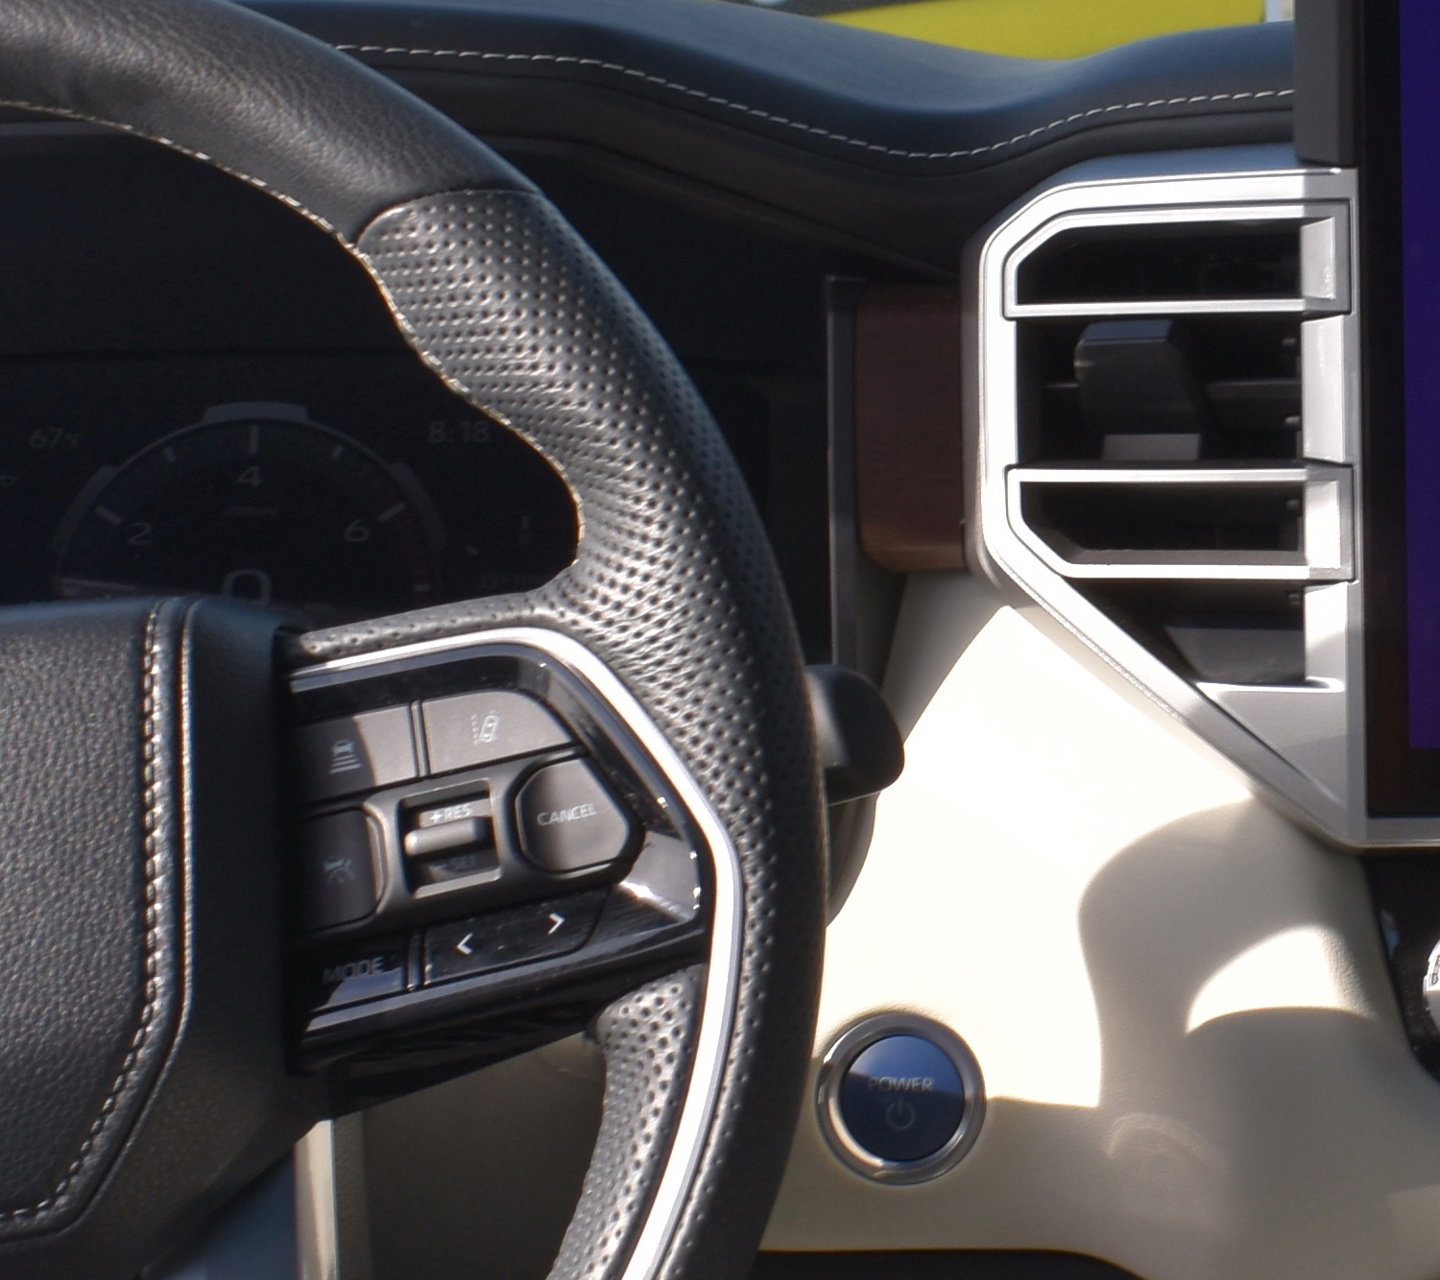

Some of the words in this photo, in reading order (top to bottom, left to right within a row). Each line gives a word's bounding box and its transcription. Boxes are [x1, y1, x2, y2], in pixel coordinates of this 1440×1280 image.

[236, 463, 262, 489] 4
[127, 521, 154, 546] 2
[343, 519, 371, 542] 6
[536, 802, 598, 827] CANCEL
[321, 955, 386, 984] MODE
[868, 1075, 936, 1092] POWER
